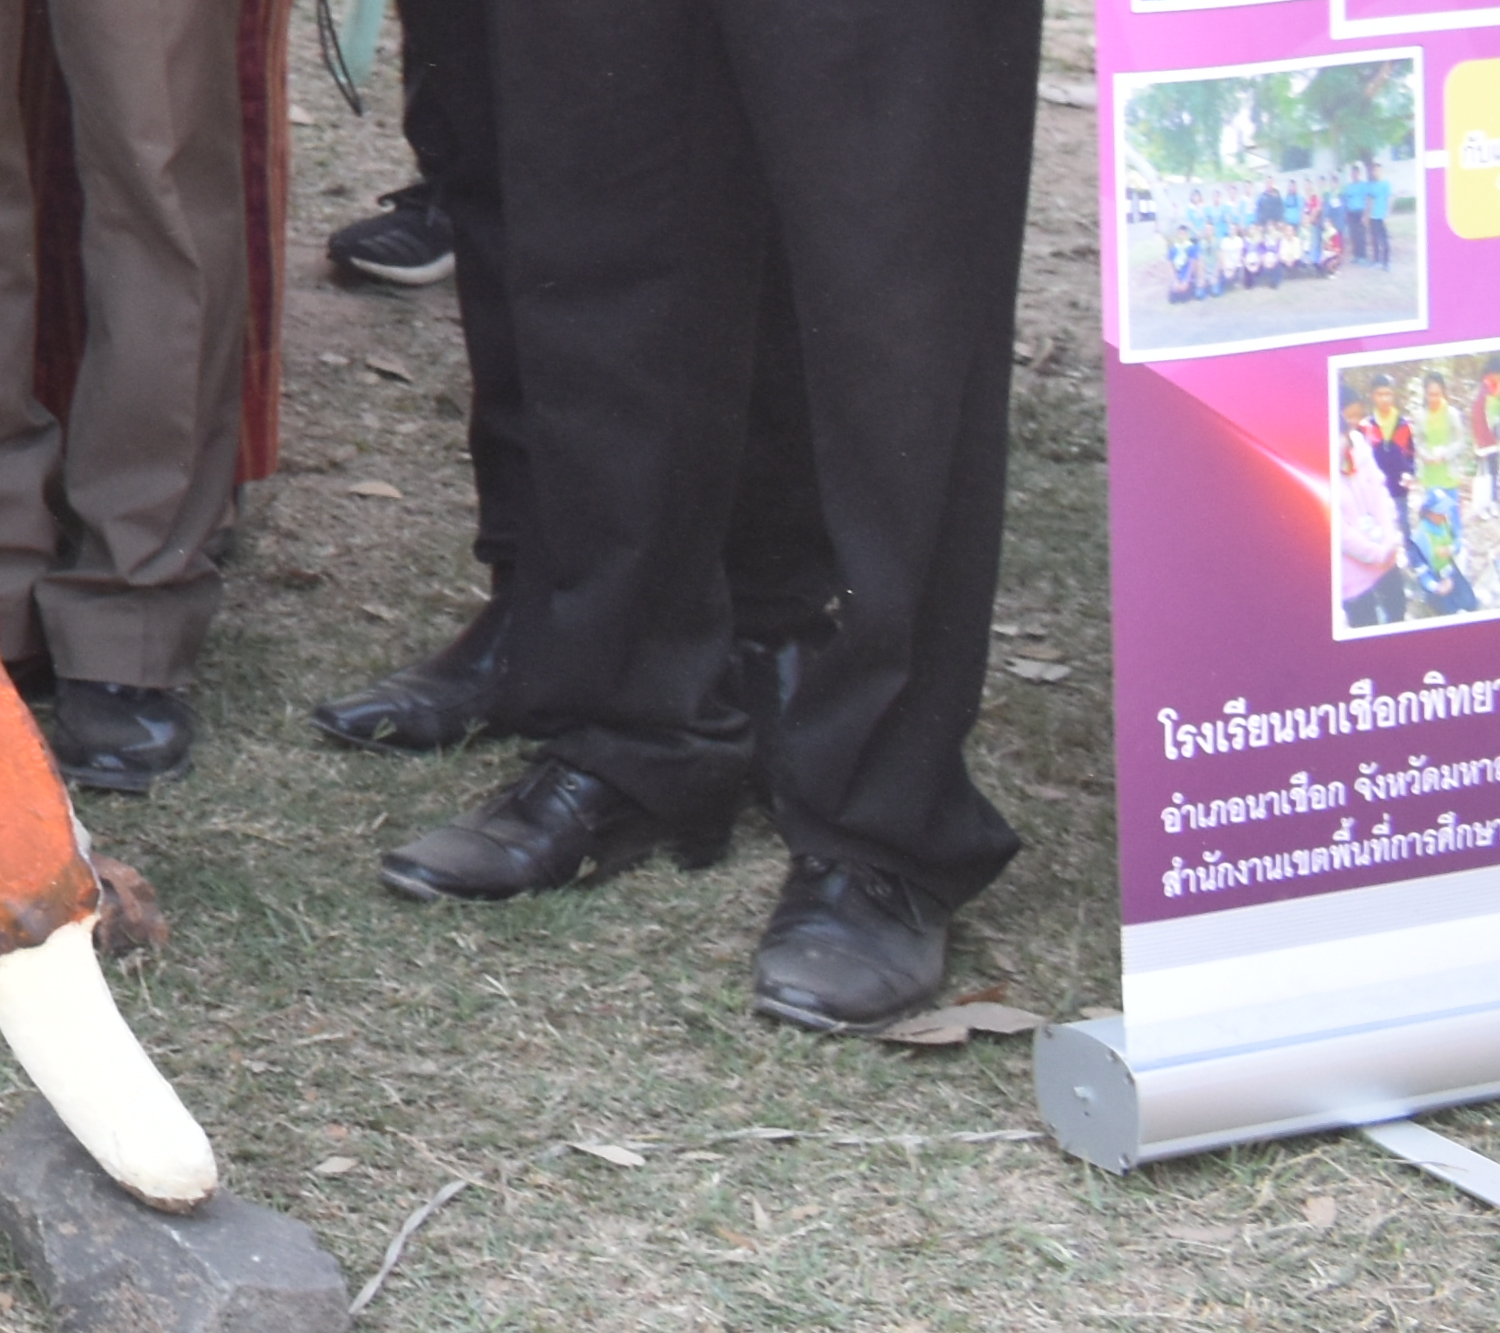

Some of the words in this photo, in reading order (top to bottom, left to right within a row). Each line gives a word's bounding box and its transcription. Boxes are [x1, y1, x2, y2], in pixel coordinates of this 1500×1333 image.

[1162, 771, 1346, 833] อำเภอนาเชือก
